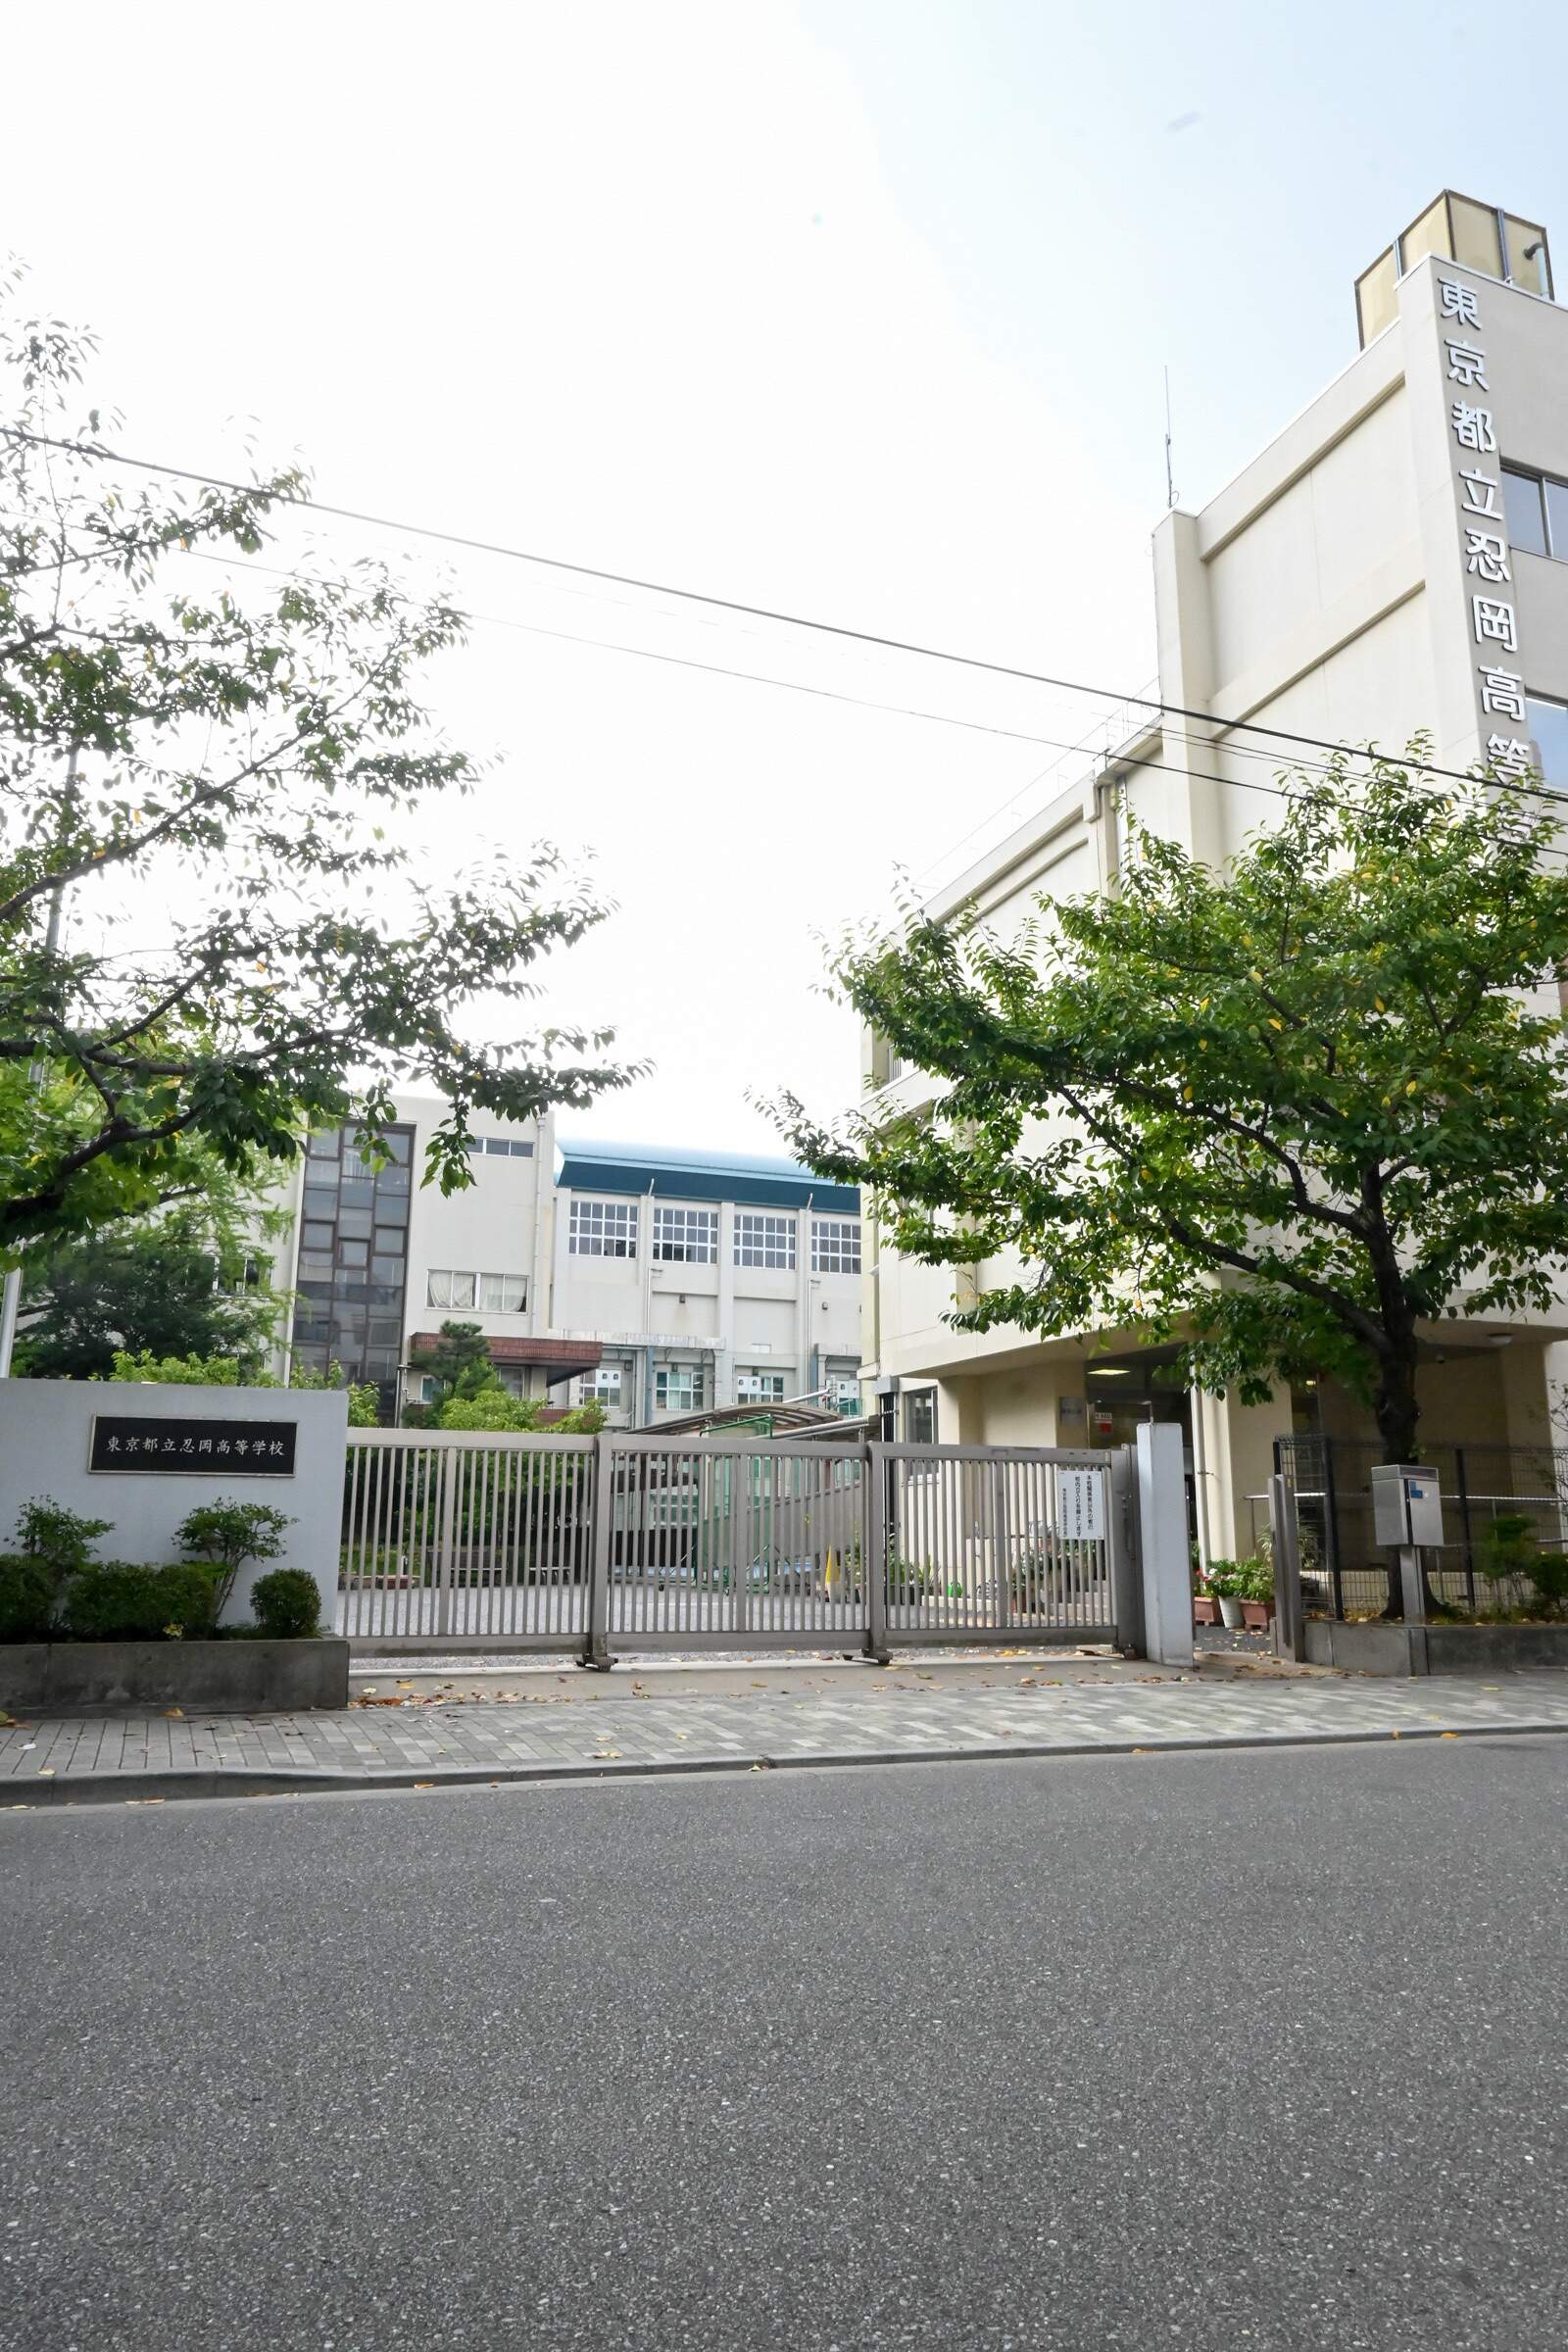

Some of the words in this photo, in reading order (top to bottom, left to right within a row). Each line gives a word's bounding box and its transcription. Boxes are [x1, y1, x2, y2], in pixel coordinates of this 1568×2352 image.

[106, 1435, 284, 1456] 東京都立忍岡高等学校
